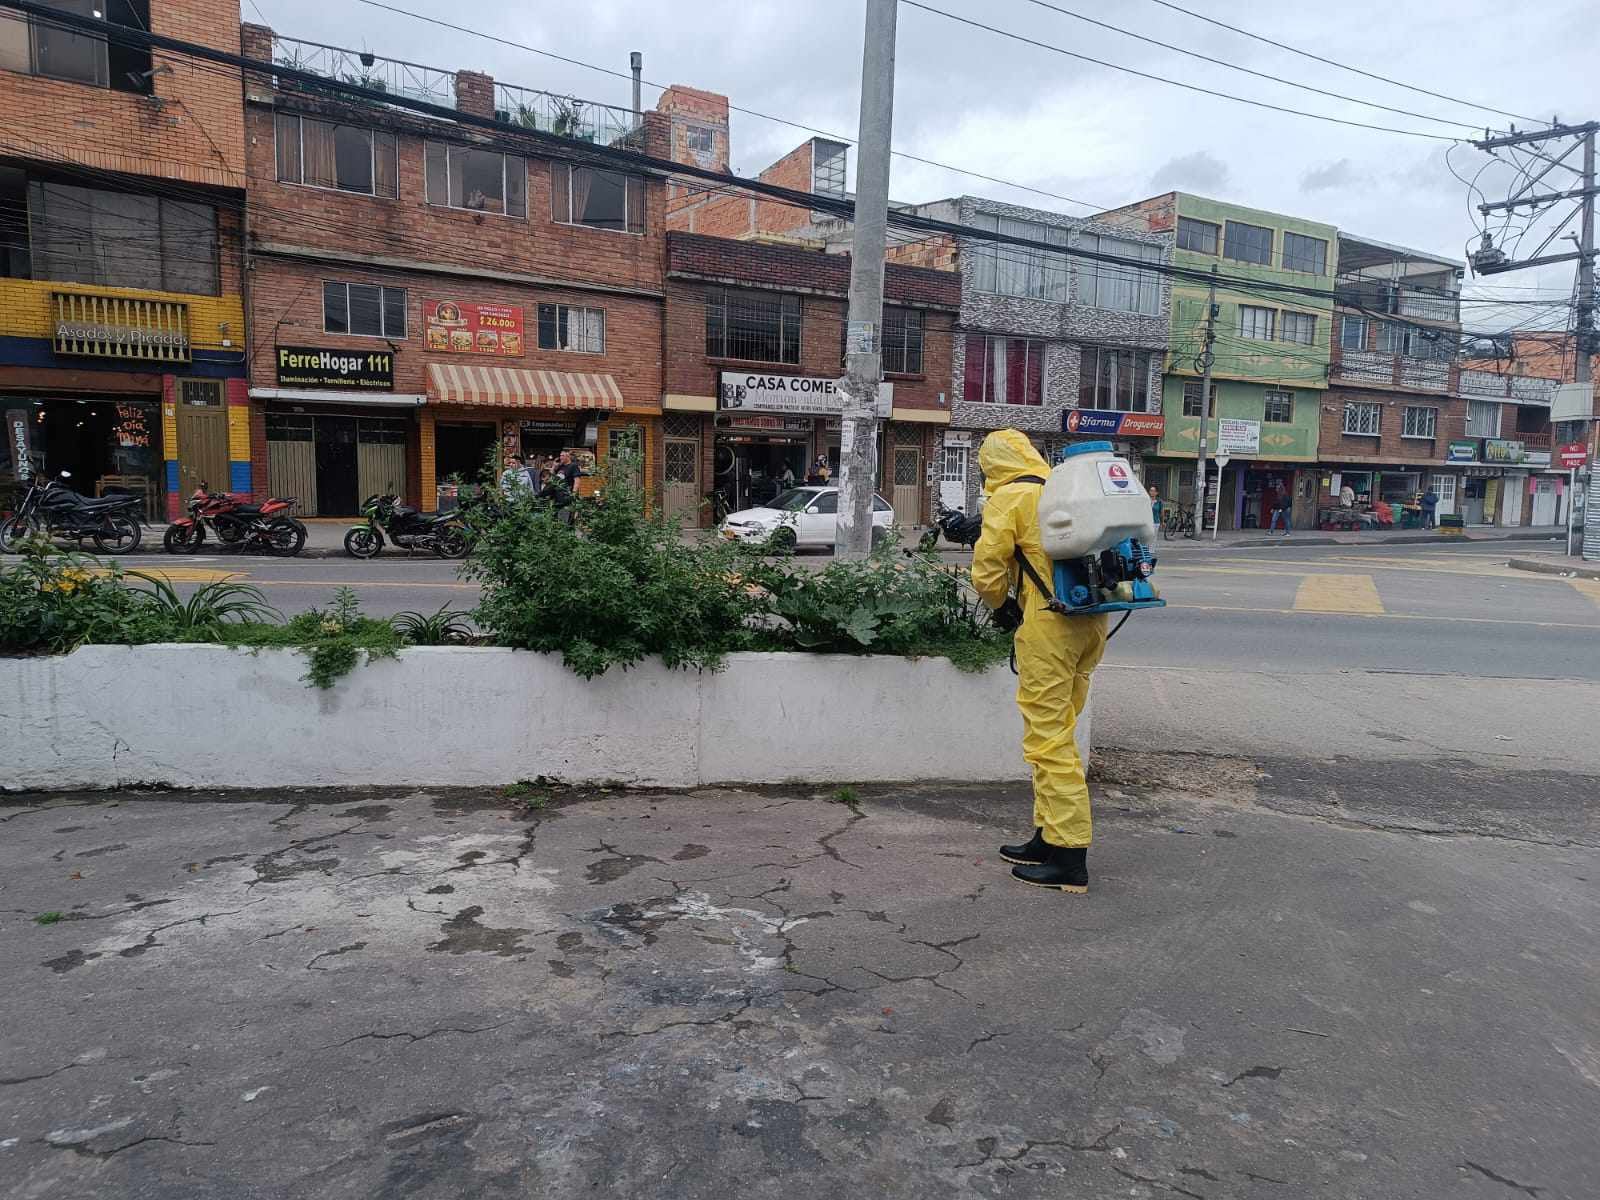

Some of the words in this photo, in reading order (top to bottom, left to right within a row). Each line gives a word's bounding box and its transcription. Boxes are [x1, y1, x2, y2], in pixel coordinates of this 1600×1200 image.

[57, 324, 113, 340] Asados
[116, 331, 126, 343] y
[280, 349, 363, 375] FerreHogar
[367, 354, 390, 373] 111
[746, 376, 786, 391] CASA
[1080, 415, 1116, 427] Sfarma
[1569, 444, 1579, 452] NO
